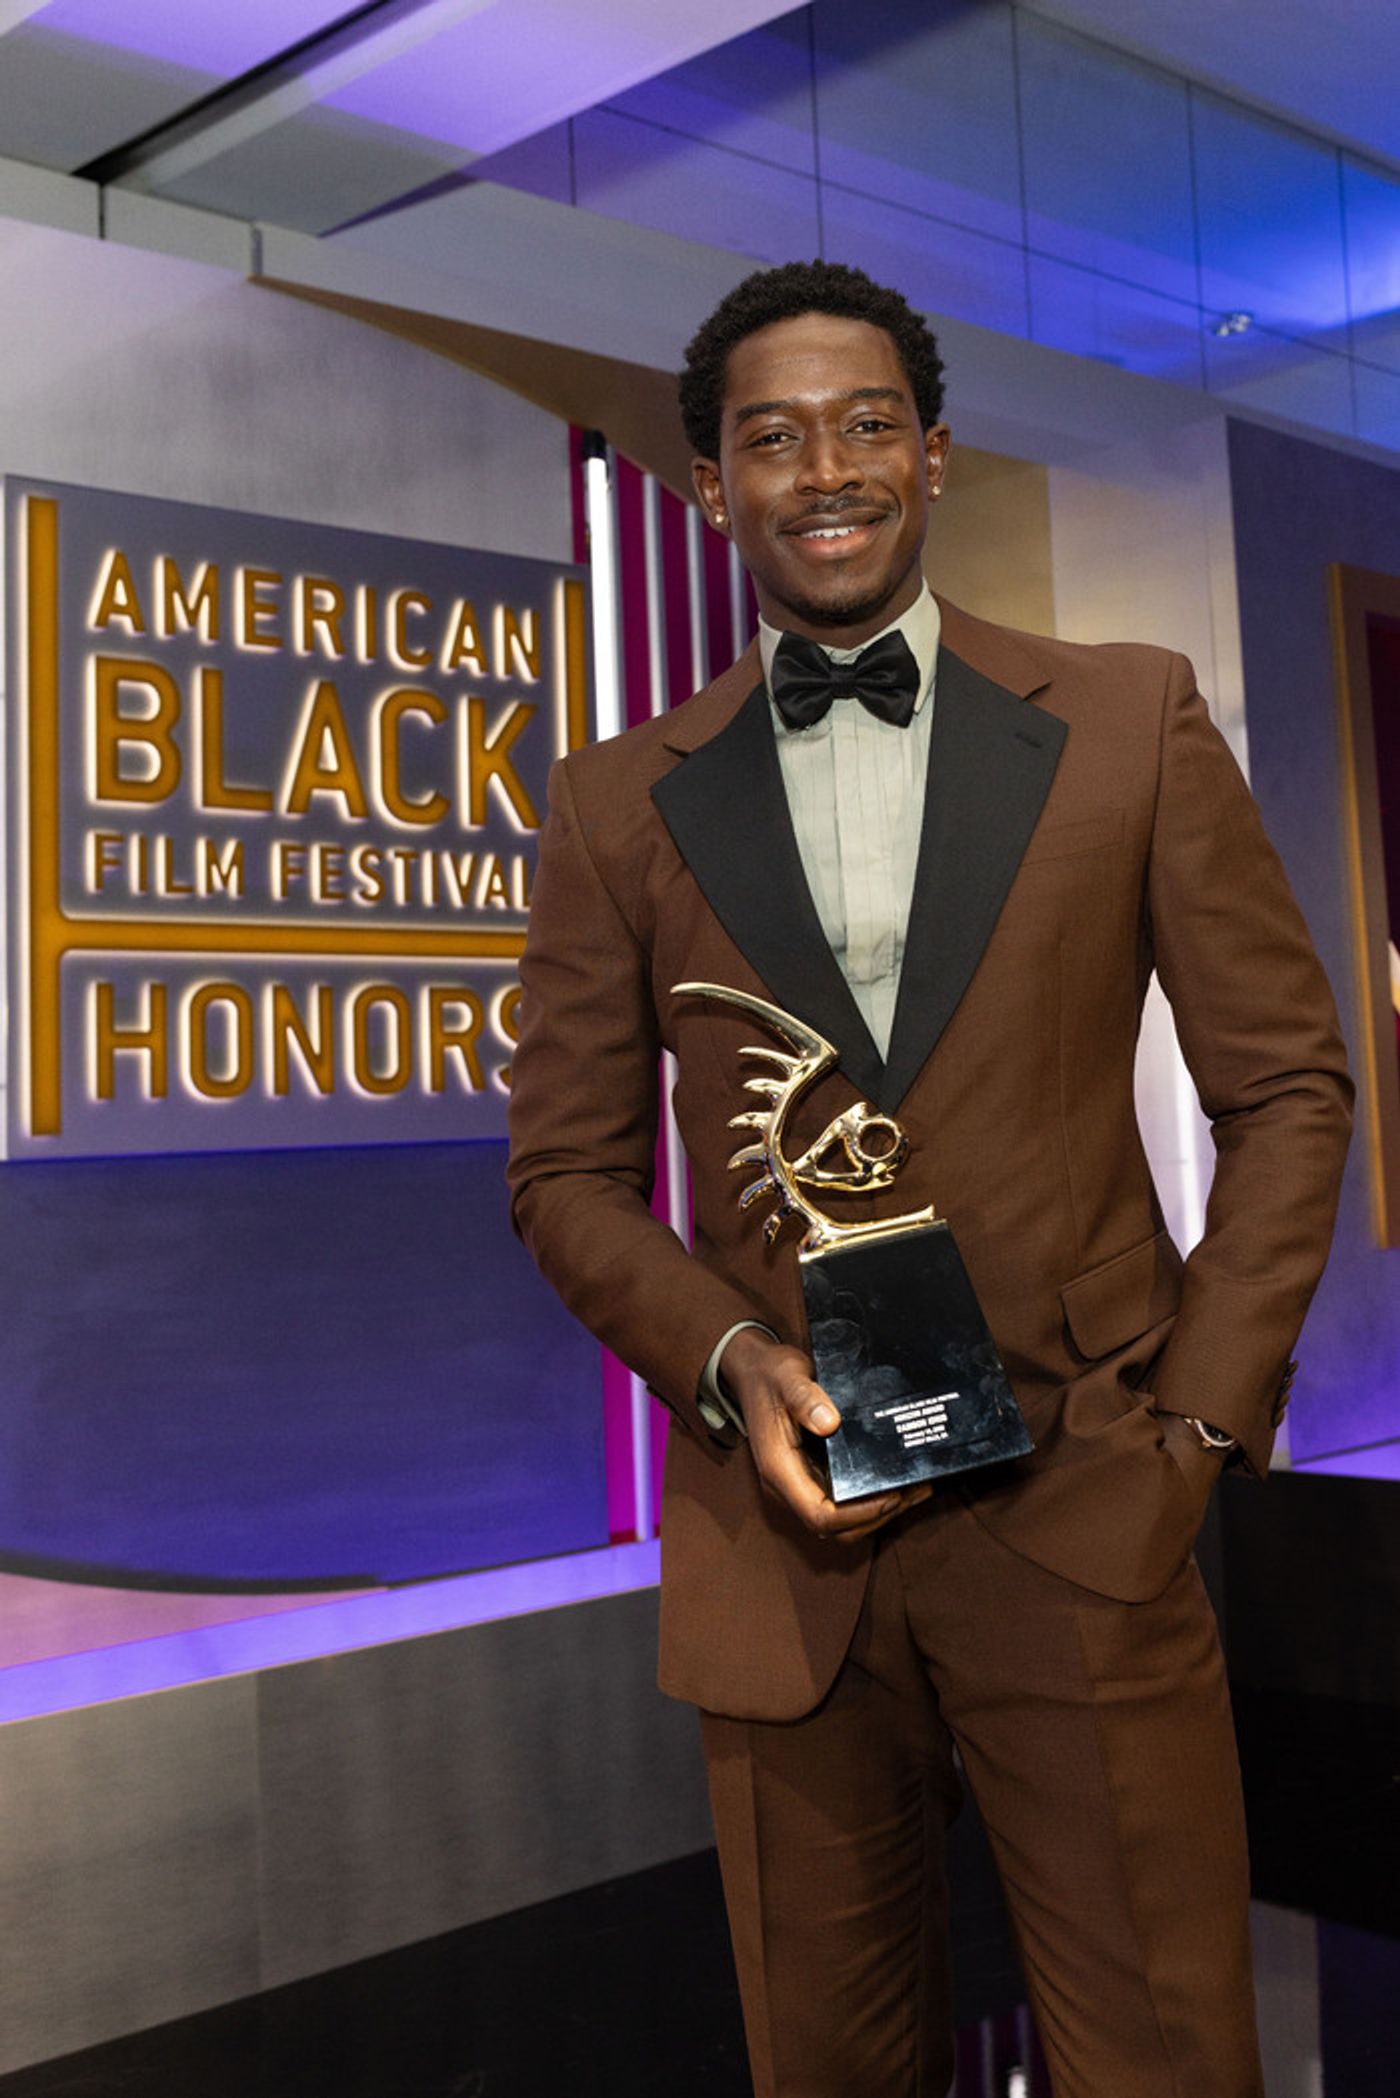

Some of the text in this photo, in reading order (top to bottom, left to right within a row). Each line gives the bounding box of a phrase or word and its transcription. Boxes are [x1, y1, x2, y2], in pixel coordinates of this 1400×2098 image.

[87, 546, 541, 684] AMERICAN
[85, 653, 541, 836] BLACK
[85, 829, 531, 913] FILM FESTIVAL
